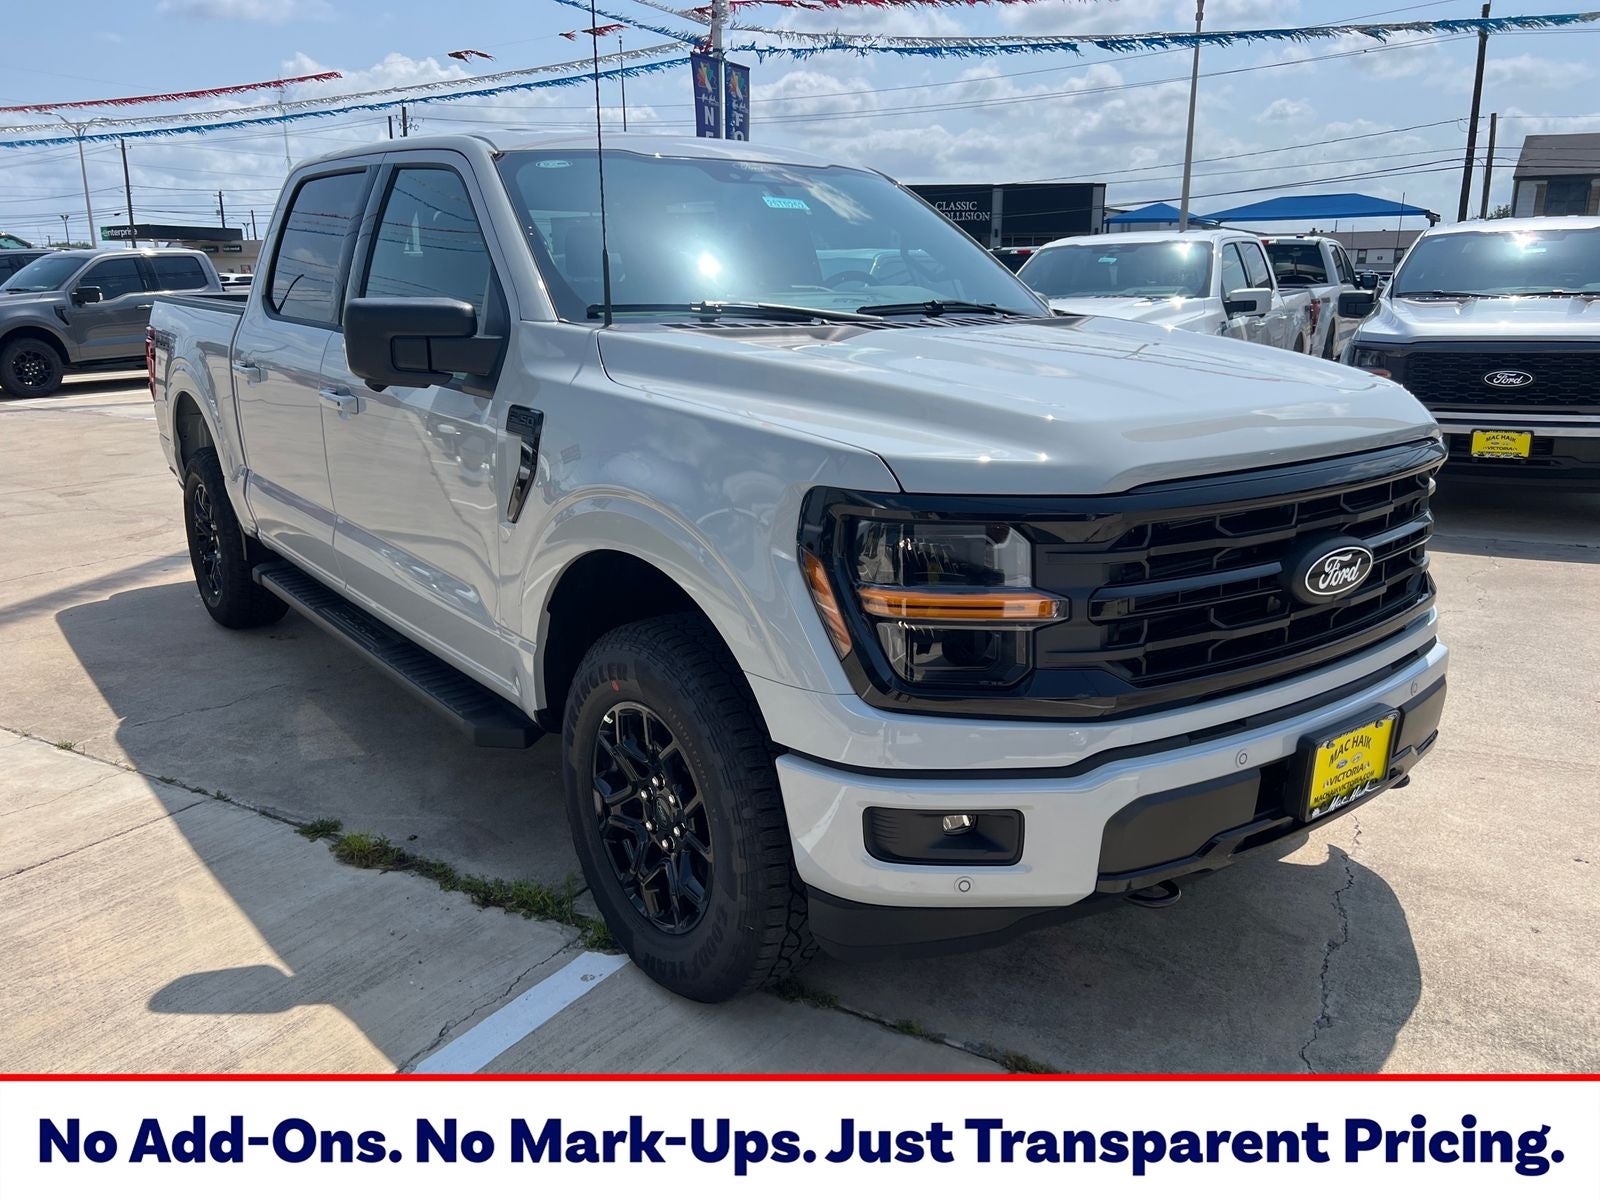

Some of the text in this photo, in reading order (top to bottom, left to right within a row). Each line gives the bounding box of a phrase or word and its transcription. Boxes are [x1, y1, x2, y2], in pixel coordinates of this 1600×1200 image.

[935, 201, 977, 210] CLASSIC
[942, 211, 991, 221] OLLISION
[102, 227, 138, 237] enterprie
[1493, 372, 1524, 384] Ford
[1485, 434, 1500, 442] MAC
[1318, 553, 1362, 590] Ford
[1329, 739, 1351, 767] MAC
[1351, 735, 1373, 750] HAIK
[1328, 762, 1365, 786] VICTORIA
[643, 902, 729, 980] GOODYEAR
